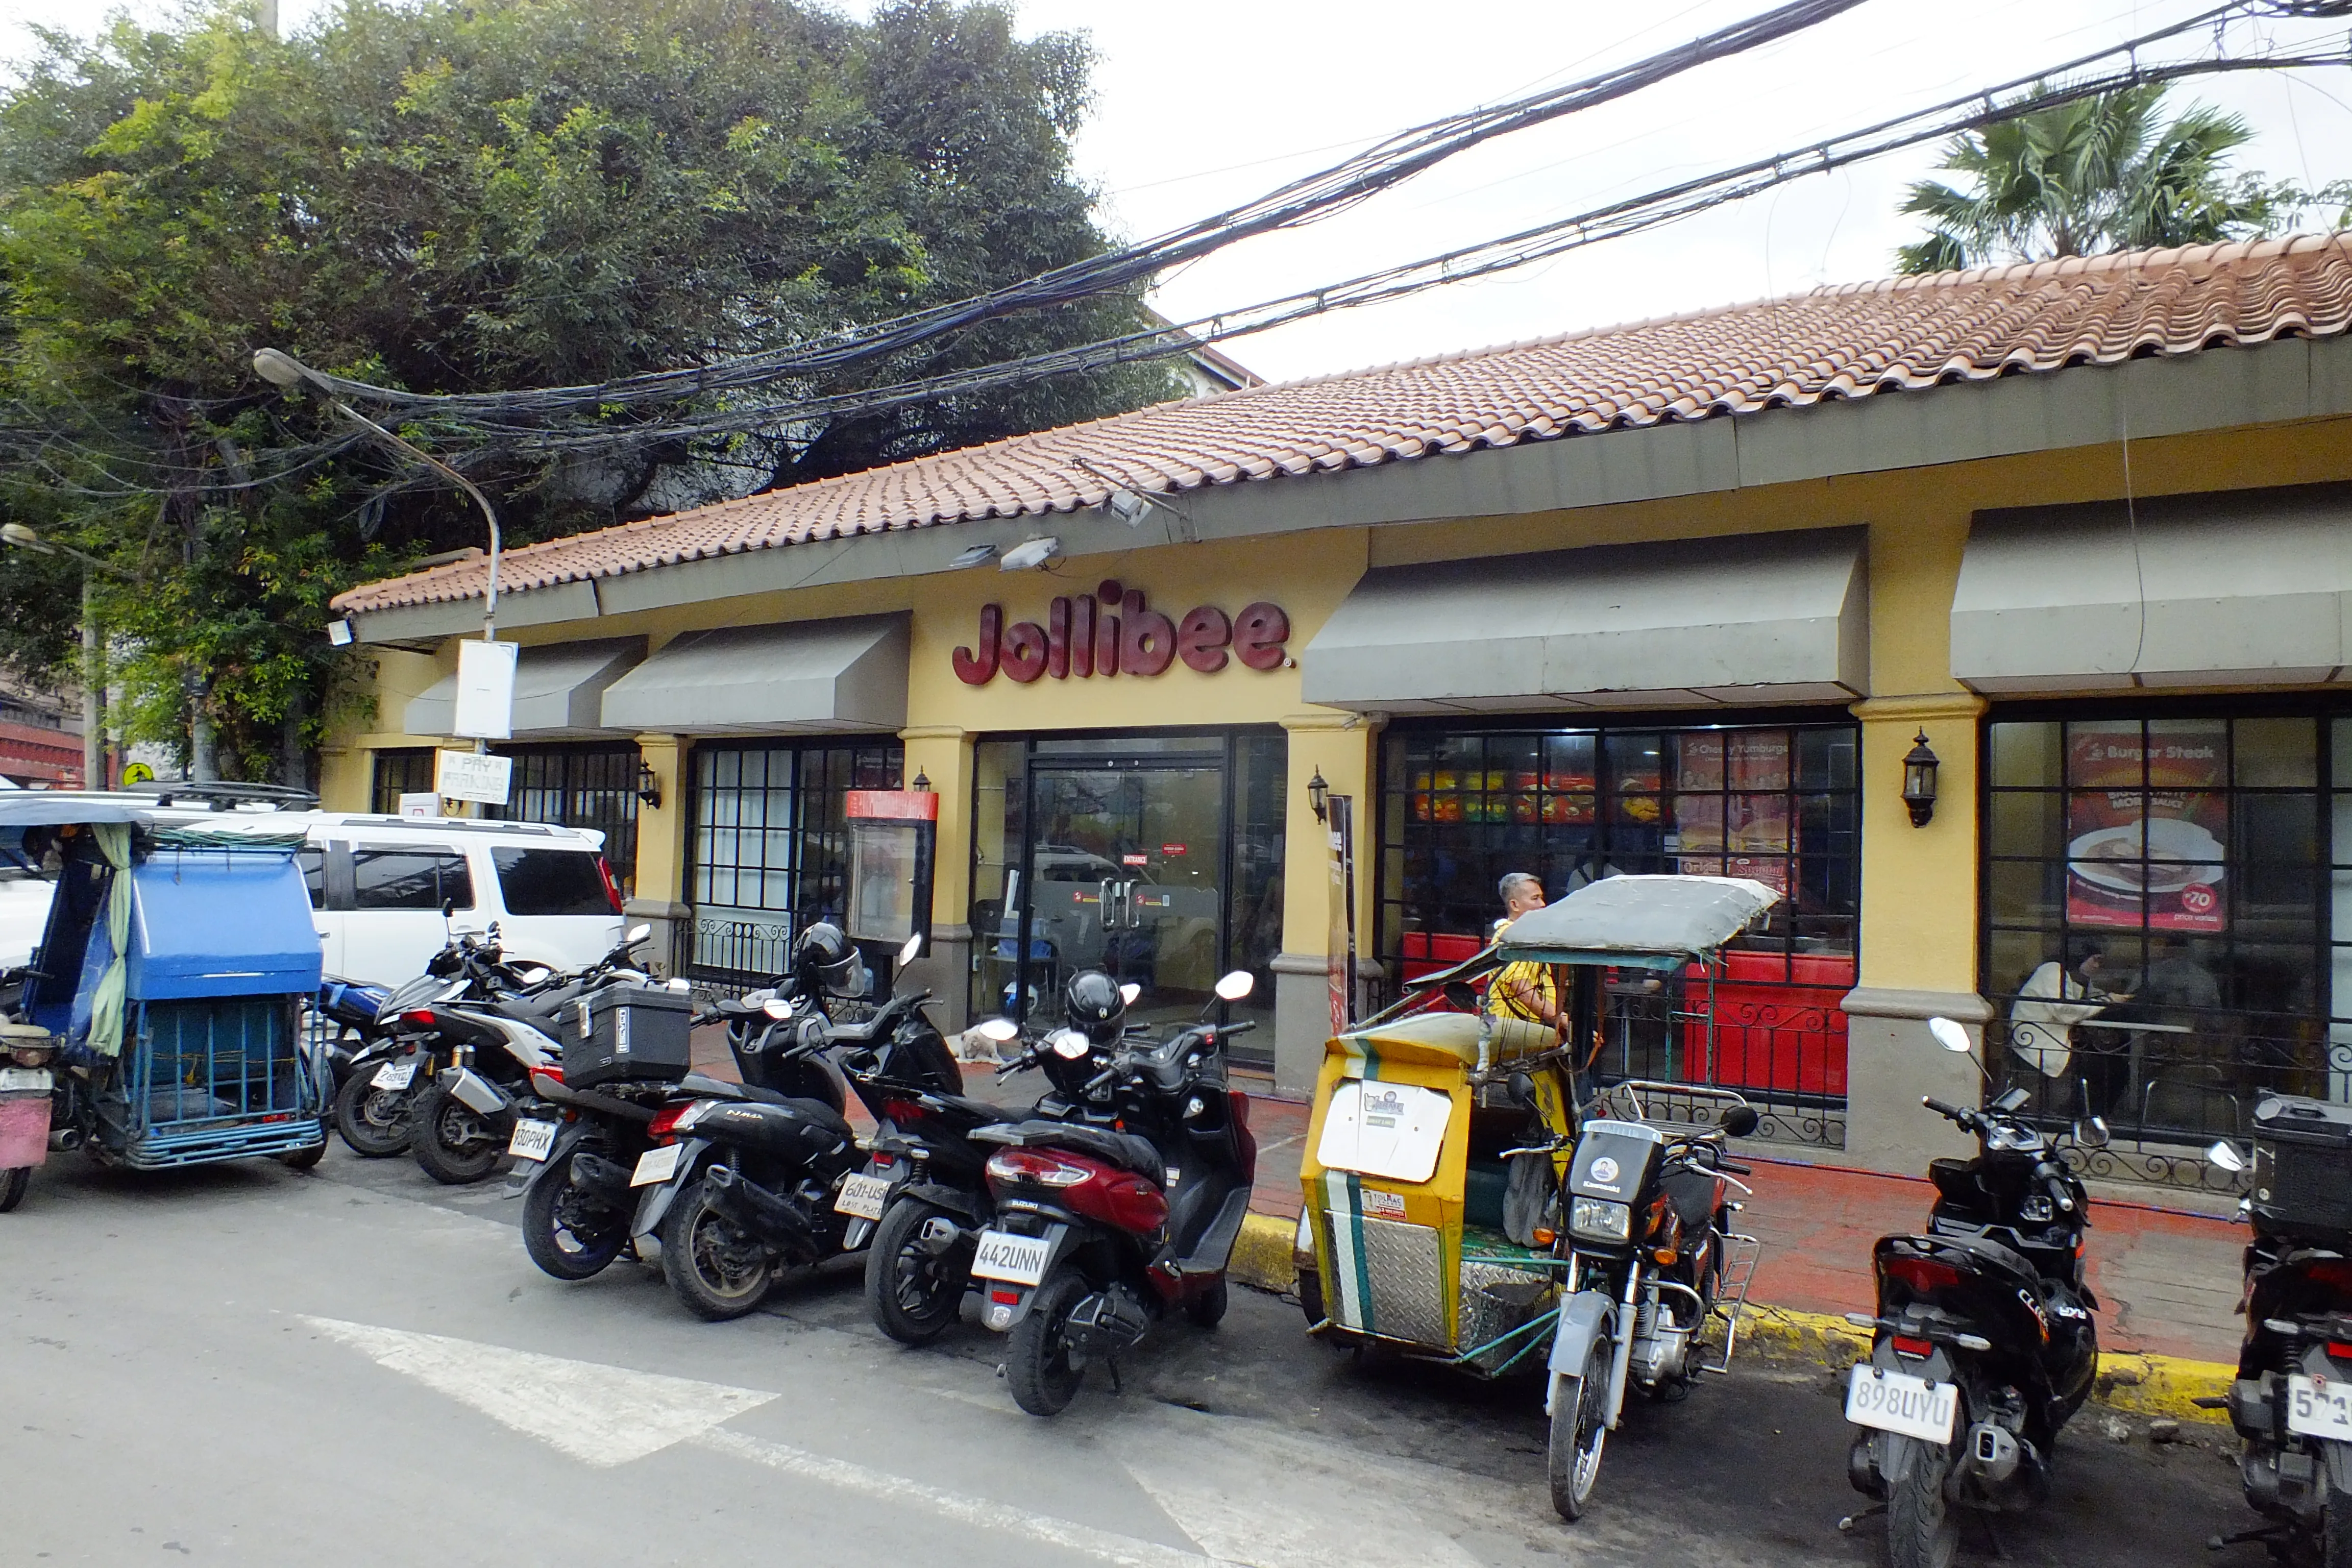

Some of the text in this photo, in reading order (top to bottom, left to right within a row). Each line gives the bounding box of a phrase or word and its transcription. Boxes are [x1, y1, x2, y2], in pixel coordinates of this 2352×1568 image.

[952, 579, 1290, 685] Jollibee
[2166, 745, 2213, 758] Steak
[461, 757, 491, 772] PAY
[513, 1129, 552, 1152] 930PHX
[842, 1200, 859, 1209] LOST
[1012, 1200, 1039, 1209] SUZUKI
[979, 1243, 1043, 1273] 442UNN
[1856, 1381, 1949, 1427] 898UYU
